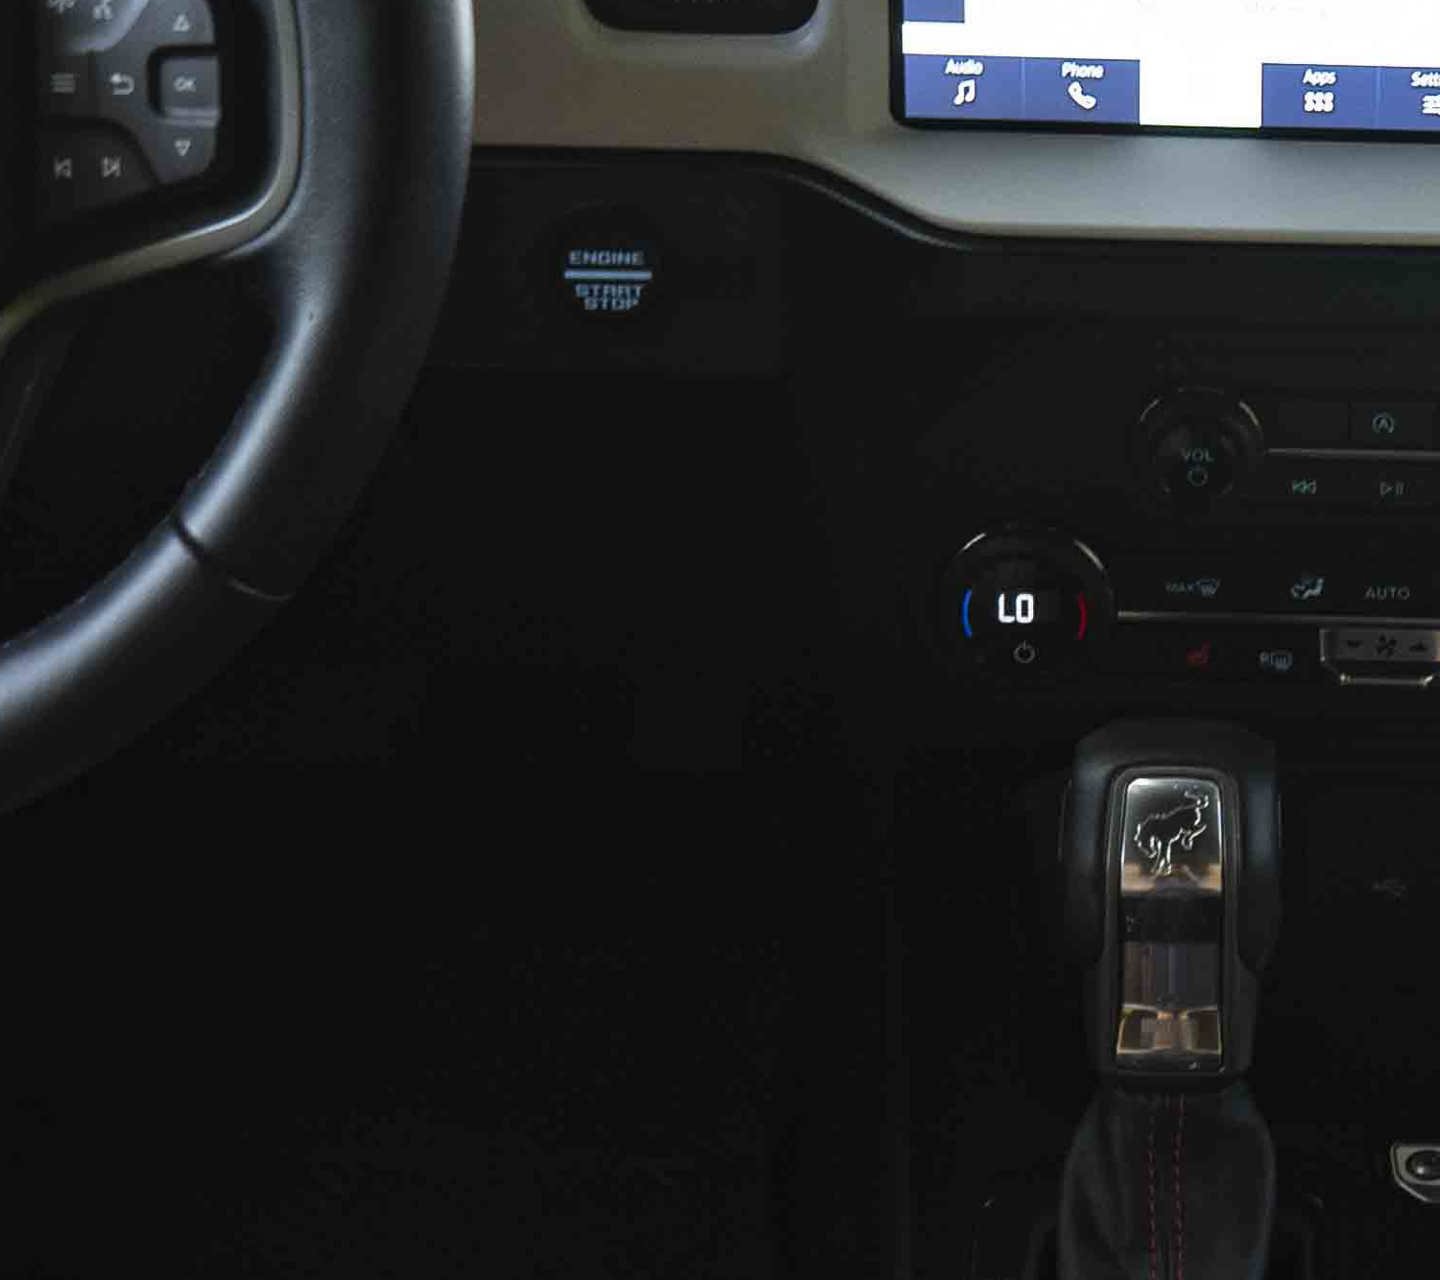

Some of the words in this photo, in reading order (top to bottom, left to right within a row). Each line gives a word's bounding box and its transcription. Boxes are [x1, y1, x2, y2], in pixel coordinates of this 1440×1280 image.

[944, 58, 983, 77] Audio
[1061, 61, 1104, 79] Phone
[1302, 69, 1336, 88] Apps
[568, 249, 644, 266] ENGINE
[575, 283, 642, 298] START
[584, 297, 639, 311] STOP
[1179, 449, 1214, 463] VOL
[1364, 585, 1411, 601] AUTO
[997, 592, 1034, 624] LO
